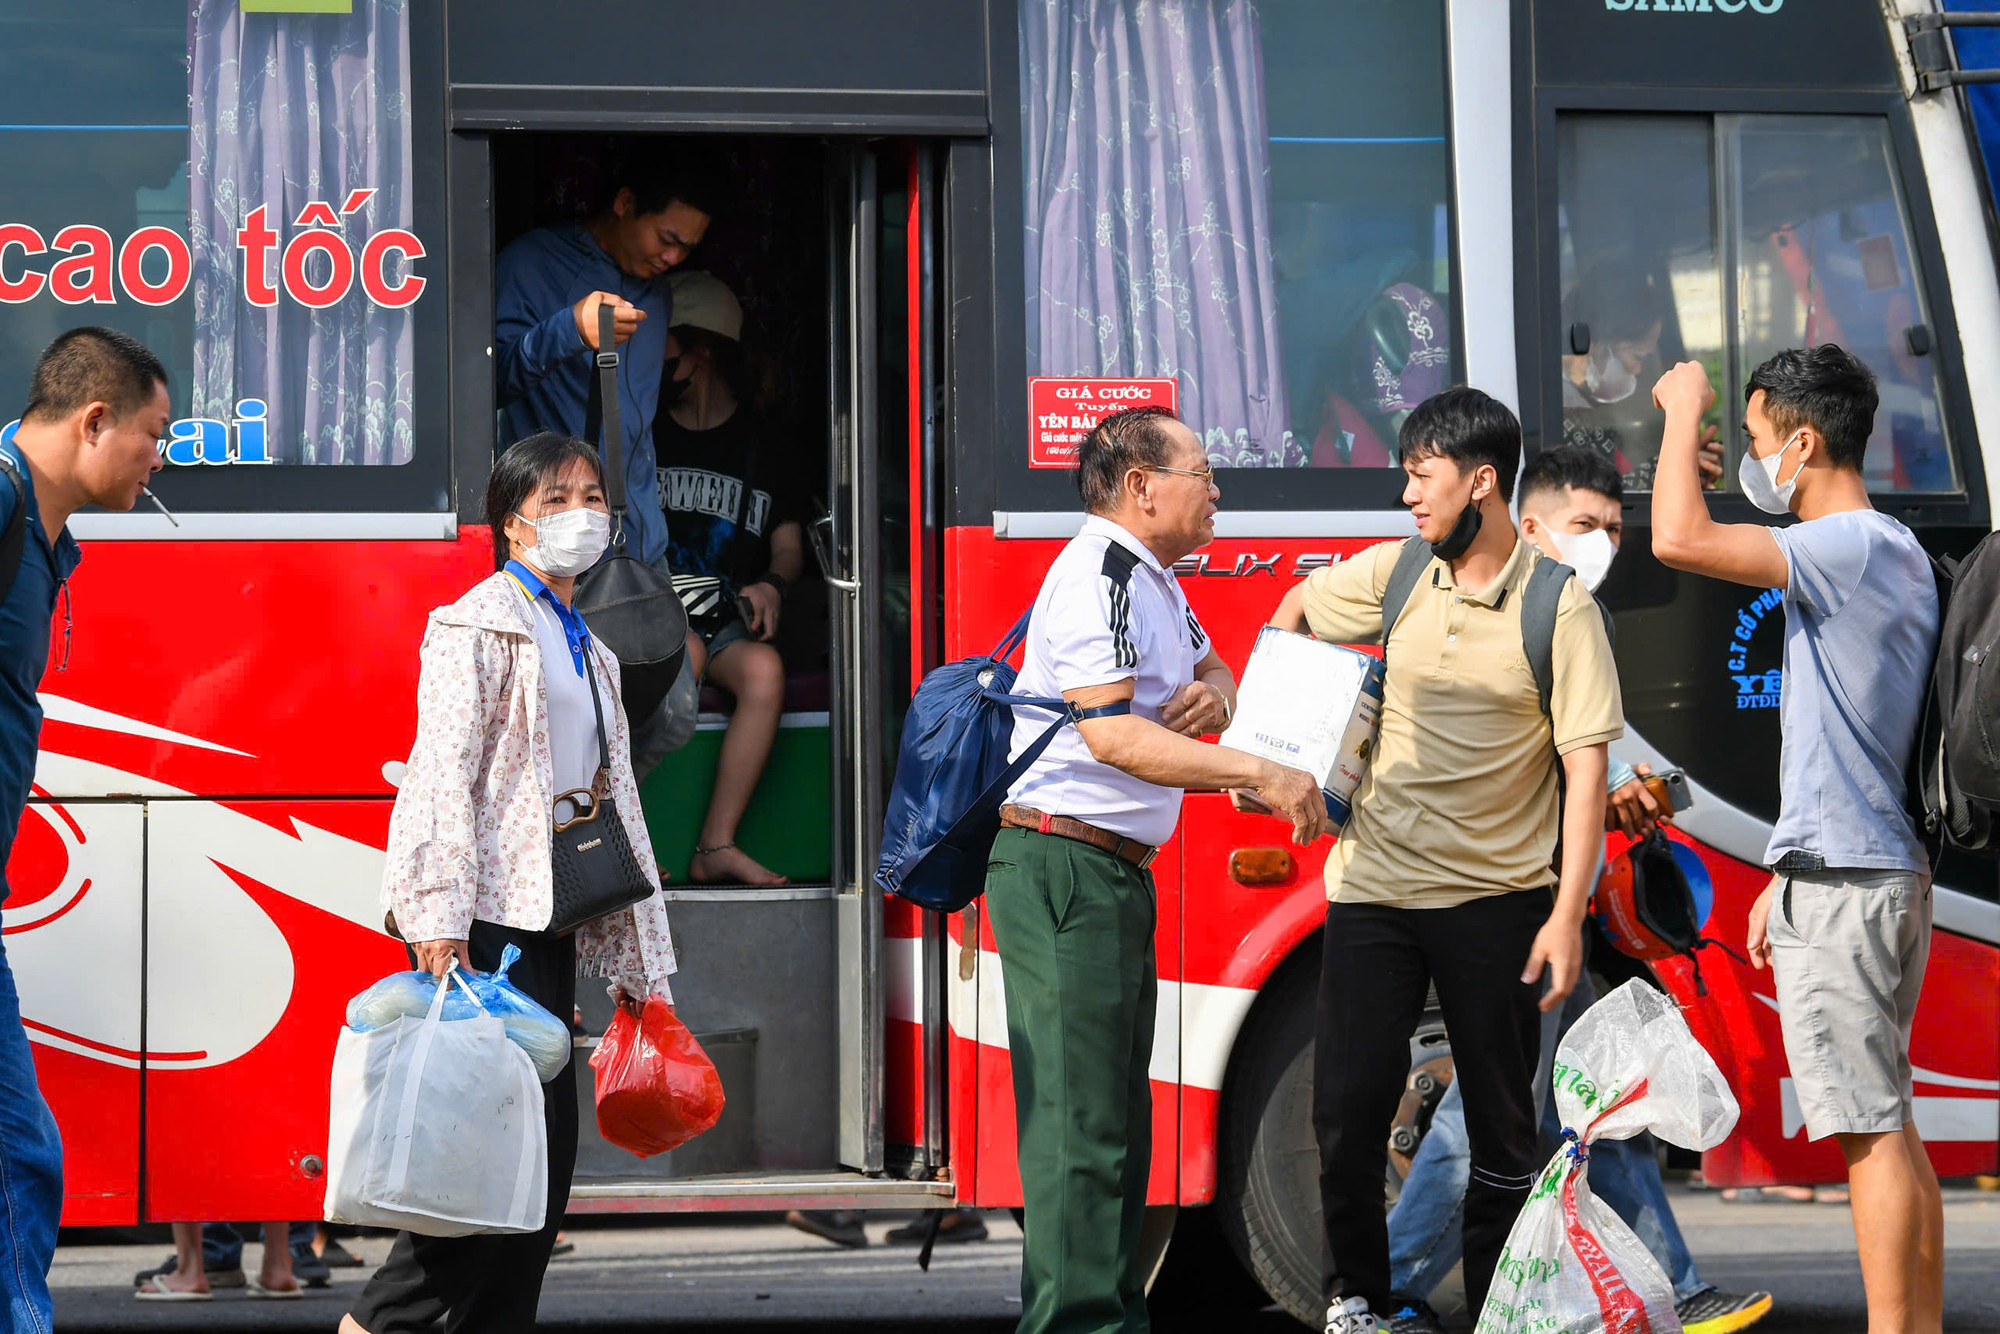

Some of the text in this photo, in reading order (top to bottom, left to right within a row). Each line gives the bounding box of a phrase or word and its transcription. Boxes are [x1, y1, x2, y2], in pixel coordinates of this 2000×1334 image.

[0, 188, 427, 309] cao tốc
[1056, 385, 1093, 399] GIÁ
[156, 398, 274, 467] ai
[1038, 413, 1067, 429] YÊN
[1173, 553, 1282, 576] ELIX
